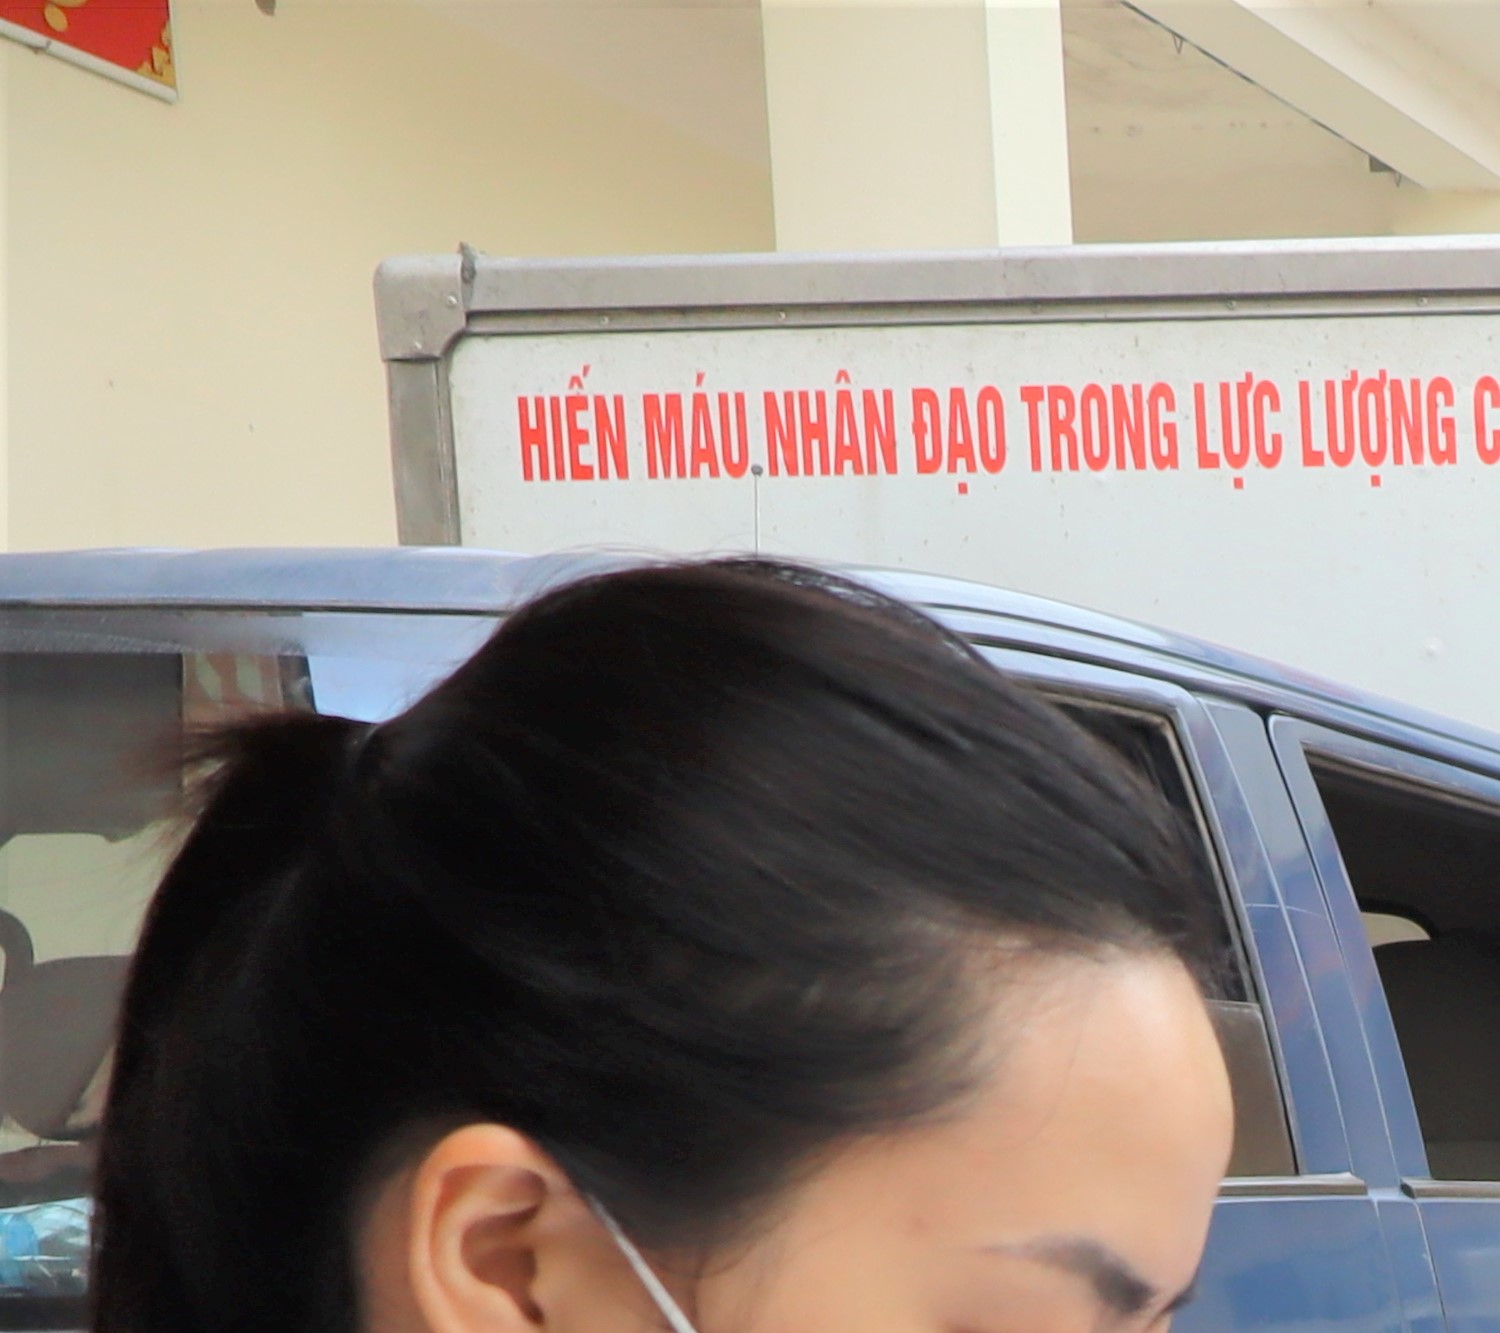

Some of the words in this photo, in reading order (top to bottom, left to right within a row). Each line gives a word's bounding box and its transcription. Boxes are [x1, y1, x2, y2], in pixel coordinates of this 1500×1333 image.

[518, 365, 628, 481] HIẾN
[642, 372, 748, 479] MÁU
[763, 369, 898, 477] NHÂN
[912, 385, 1007, 494] ĐẠO
[1020, 382, 1179, 472] TRONG
[1194, 372, 1283, 489] LỰC
[1300, 369, 1457, 487] LƯỢNG
